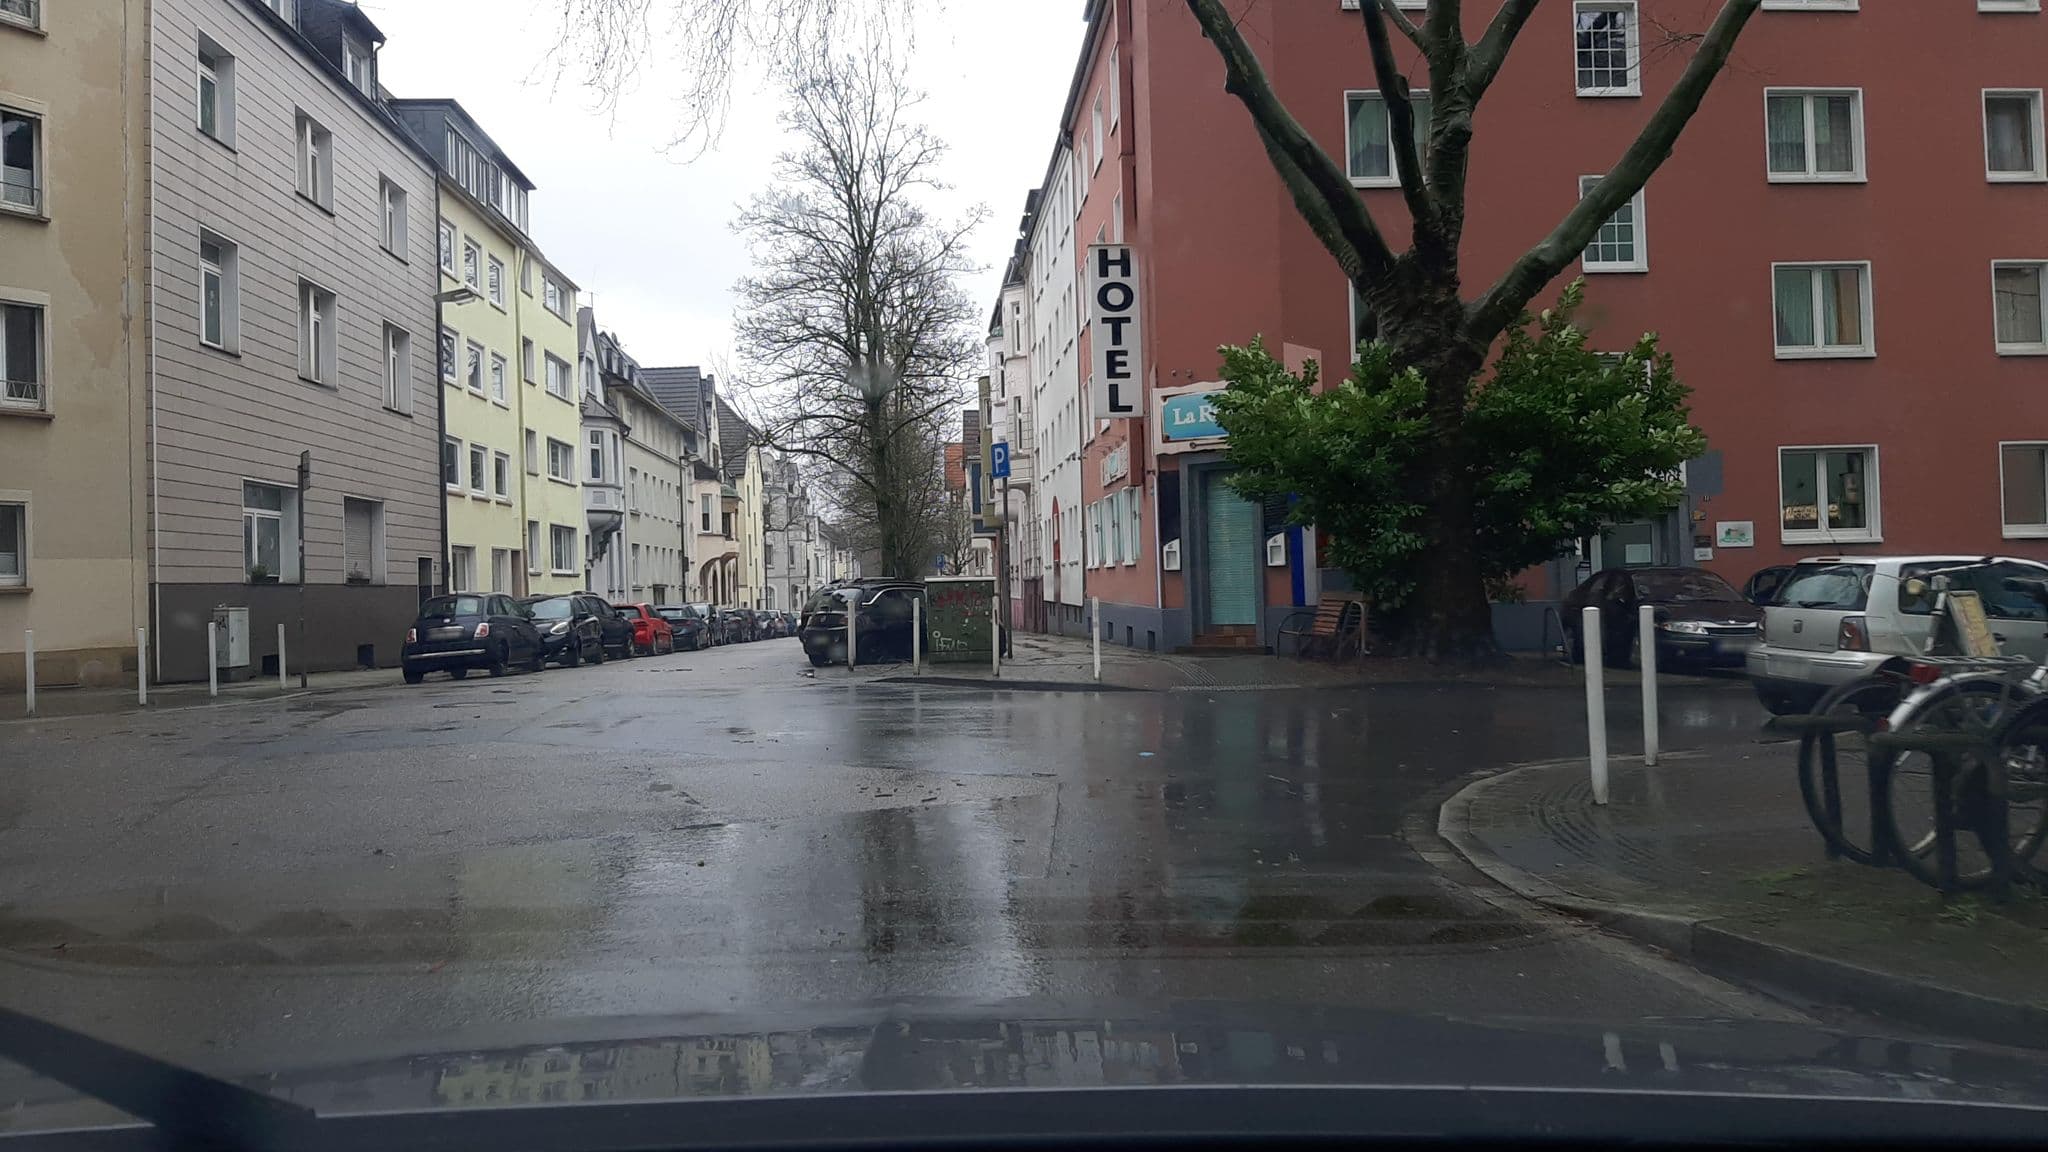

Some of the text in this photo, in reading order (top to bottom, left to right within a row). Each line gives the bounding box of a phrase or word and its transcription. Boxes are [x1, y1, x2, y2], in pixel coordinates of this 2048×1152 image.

[1097, 248, 1134, 413] HOTEL
[1172, 405, 1220, 425] La R
[994, 447, 1005, 474] P
